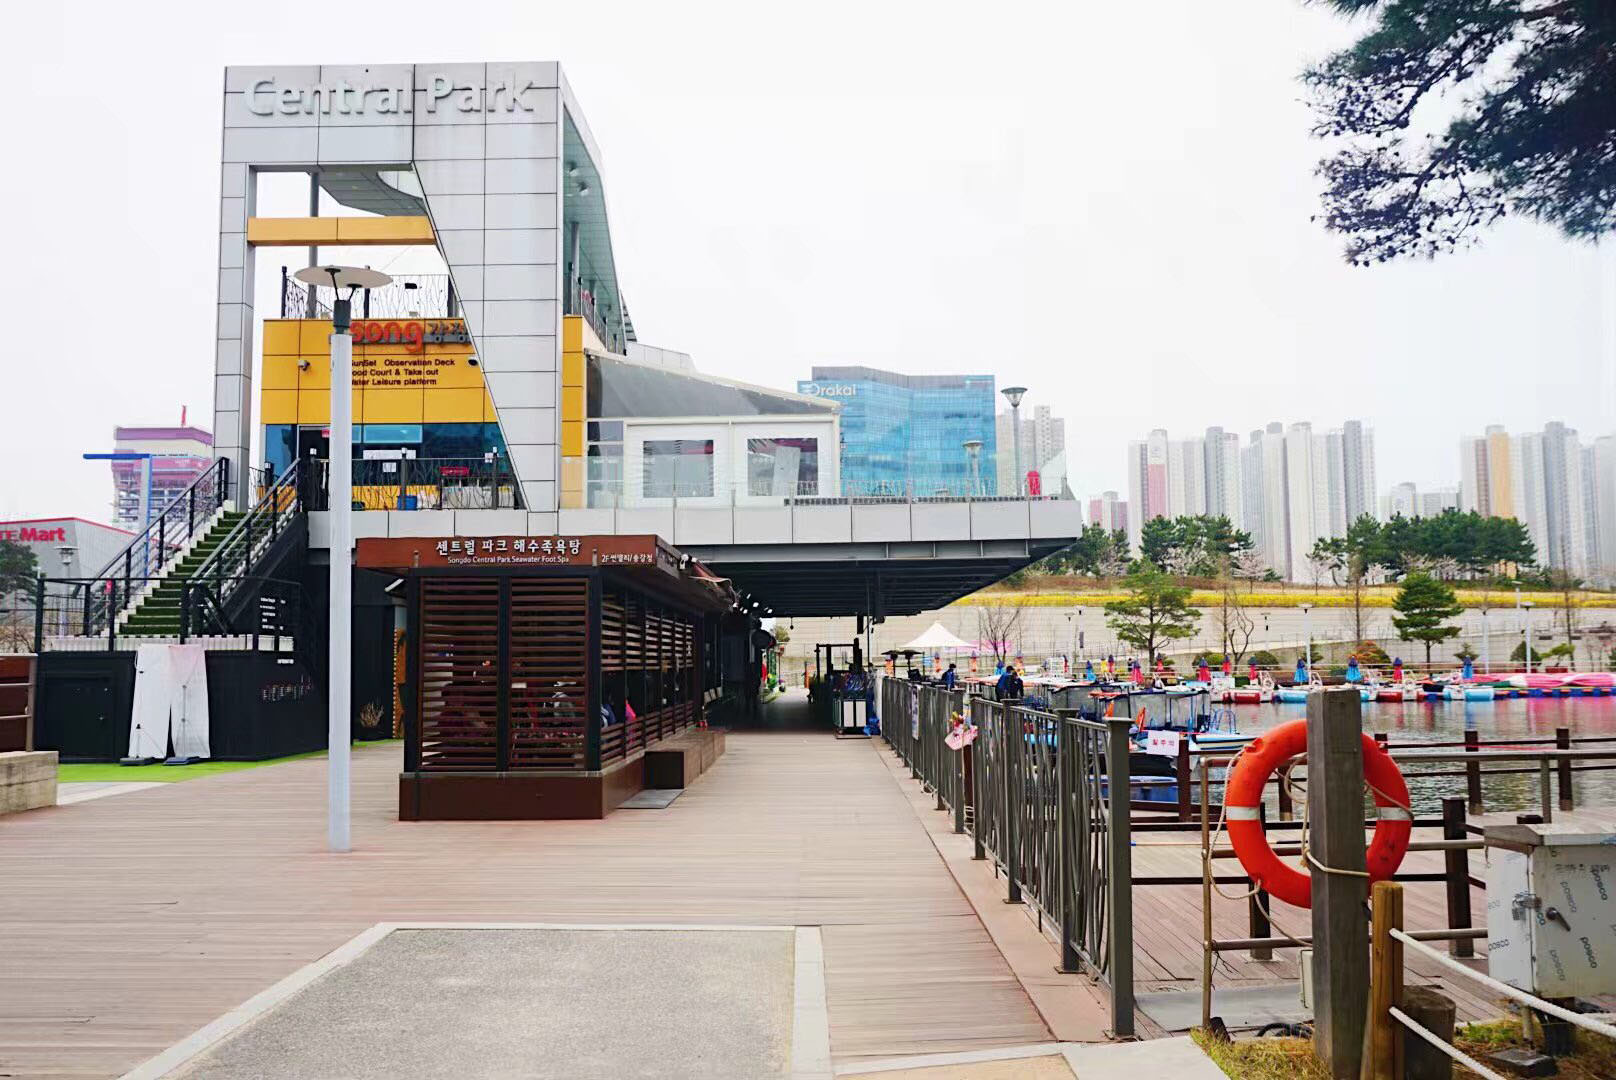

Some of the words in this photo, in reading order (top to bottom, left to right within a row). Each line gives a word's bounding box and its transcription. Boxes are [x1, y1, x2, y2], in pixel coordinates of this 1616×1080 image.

[246, 72, 414, 117] Central
[426, 71, 535, 114] Park
[384, 358, 432, 367] Observation
[434, 358, 456, 366] Deck
[370, 368, 392, 377] Court
[394, 368, 401, 376] &
[372, 378, 401, 386] Leisure
[404, 378, 437, 387] platform
[21, 527, 66, 542] Mart
[436, 539, 475, 555] 센트럴
[482, 539, 508, 553] 파크
[513, 539, 581, 555] 해수족욕탕
[447, 556, 472, 565] Songdo
[473, 555, 496, 564] Central
[497, 555, 511, 563] Park
[511, 555, 540, 563] Seawater
[541, 555, 557, 563] Foot
[558, 555, 570, 564] Spa
[1579, 936, 1598, 969] posco
